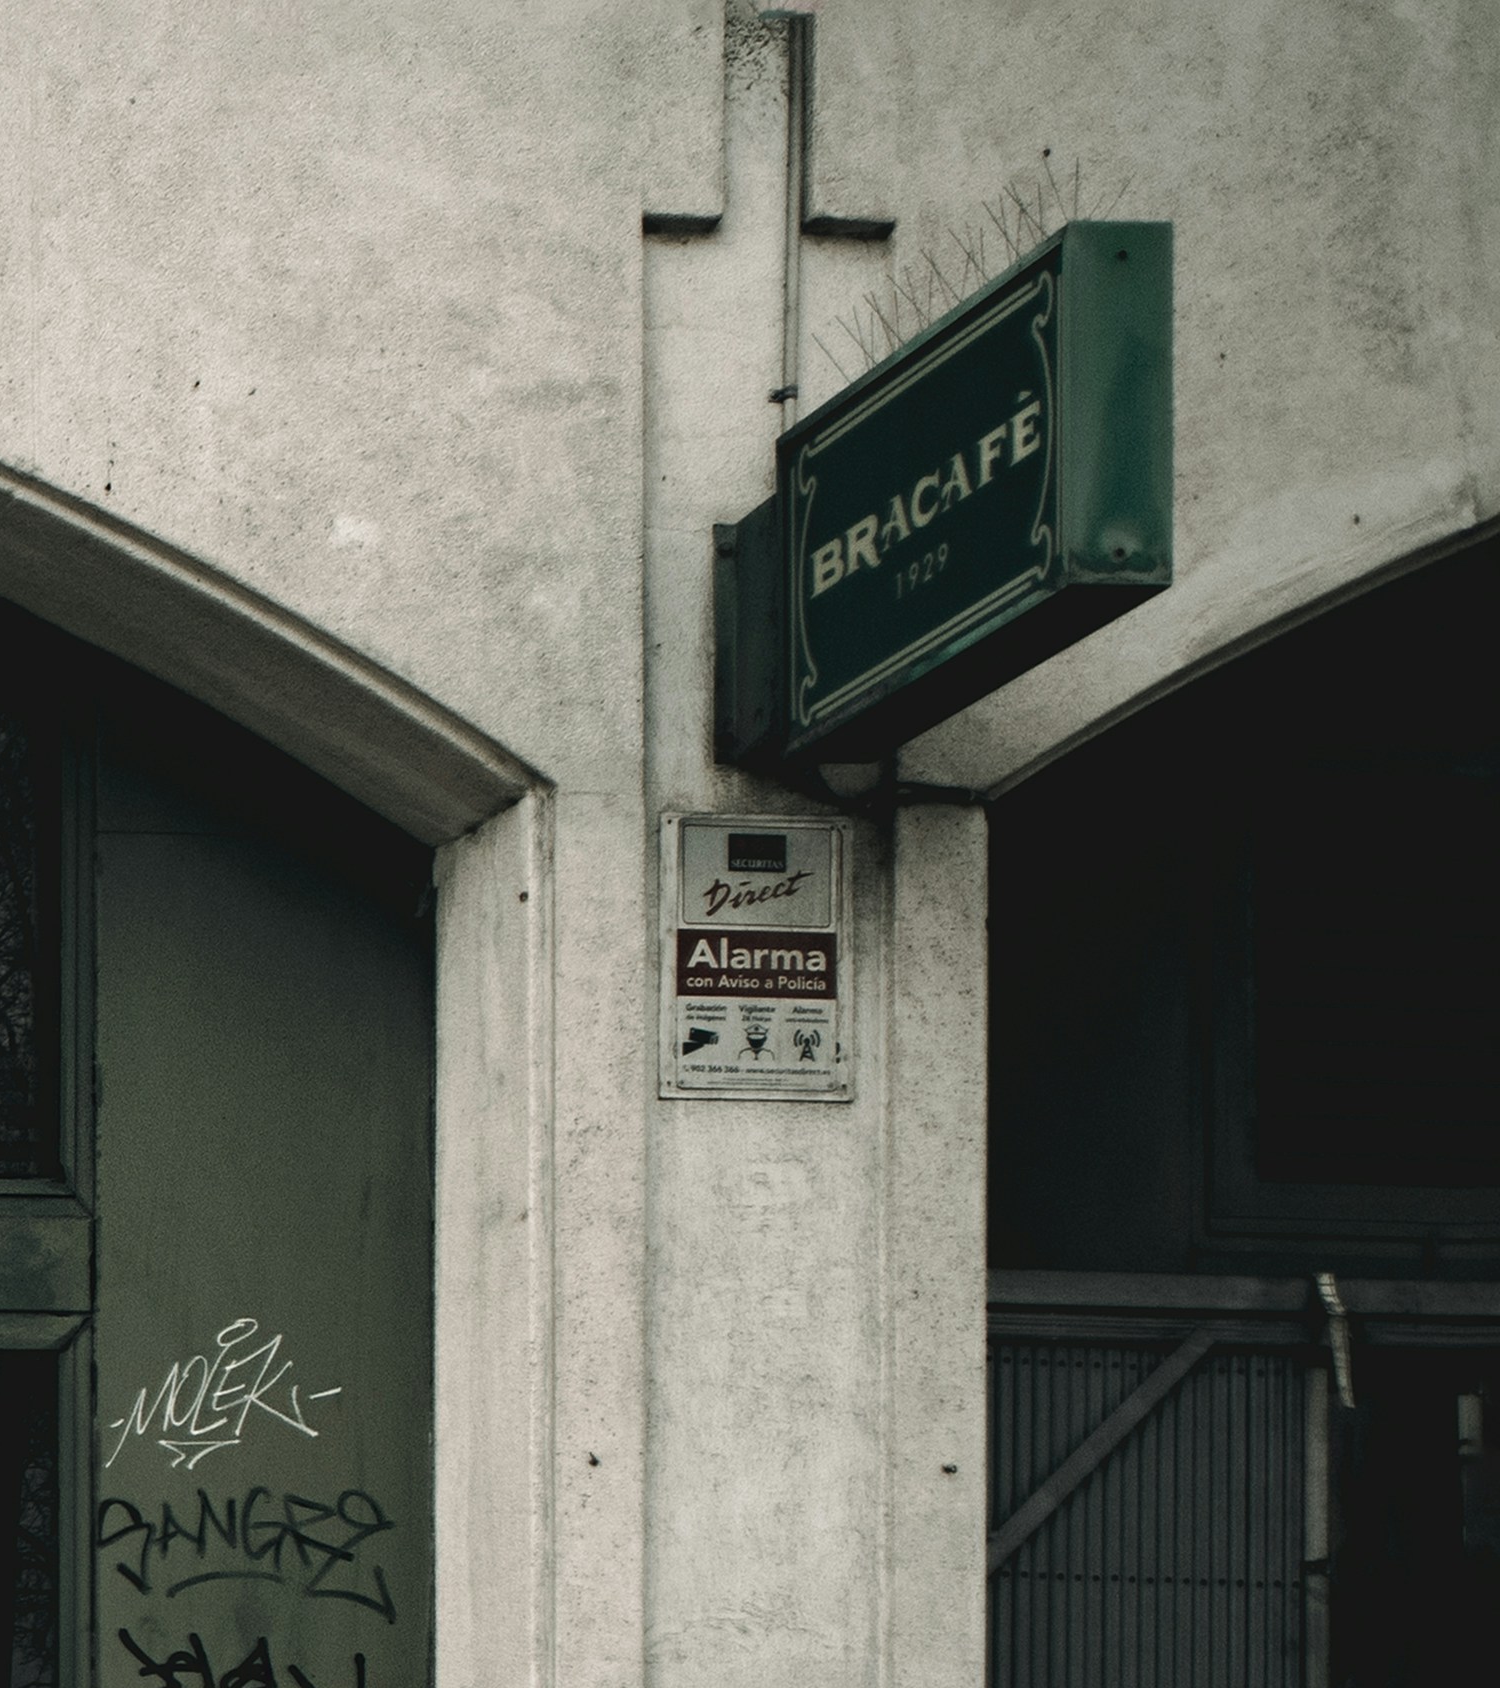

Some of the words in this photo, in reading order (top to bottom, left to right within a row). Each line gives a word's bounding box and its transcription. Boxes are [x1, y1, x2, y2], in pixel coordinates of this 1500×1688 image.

[703, 870, 815, 917] Direct
[686, 938, 827, 972] Alarma
[686, 976, 713, 988] con
[717, 974, 760, 989] Aviso
[764, 979, 774, 990] a
[778, 976, 826, 991] Policía
